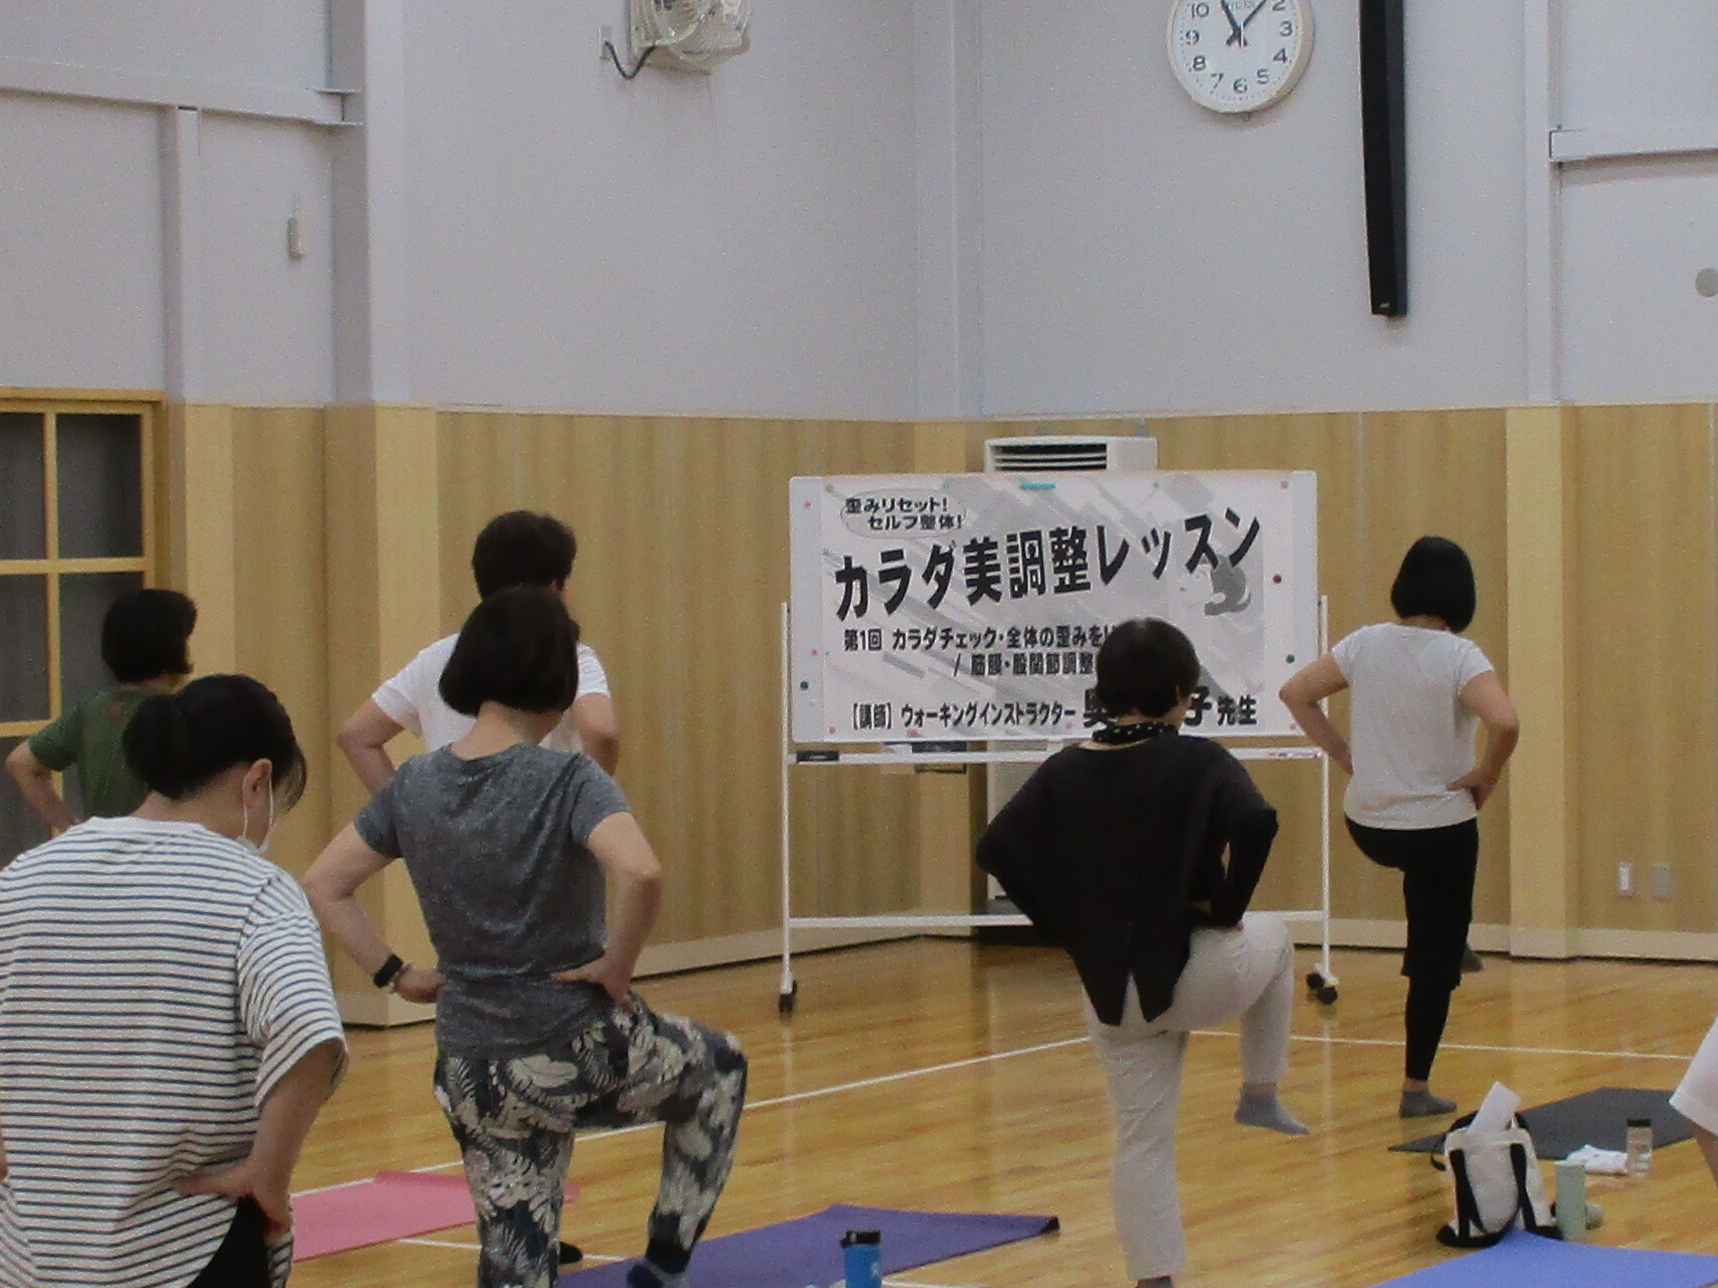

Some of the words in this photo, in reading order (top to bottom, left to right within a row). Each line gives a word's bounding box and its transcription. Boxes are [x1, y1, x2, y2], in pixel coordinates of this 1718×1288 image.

[1191, 2, 1210, 19] 10
[1185, 29, 1200, 45] 9
[1279, 20, 1293, 37] 3
[1192, 55, 1207, 71] 8
[1272, 47, 1287, 64] 4
[1210, 72, 1224, 89] 7
[1256, 68, 1269, 85] 5
[1233, 78, 1248, 94] 6
[835, 507, 1260, 622] カラダ美調整レッスン
